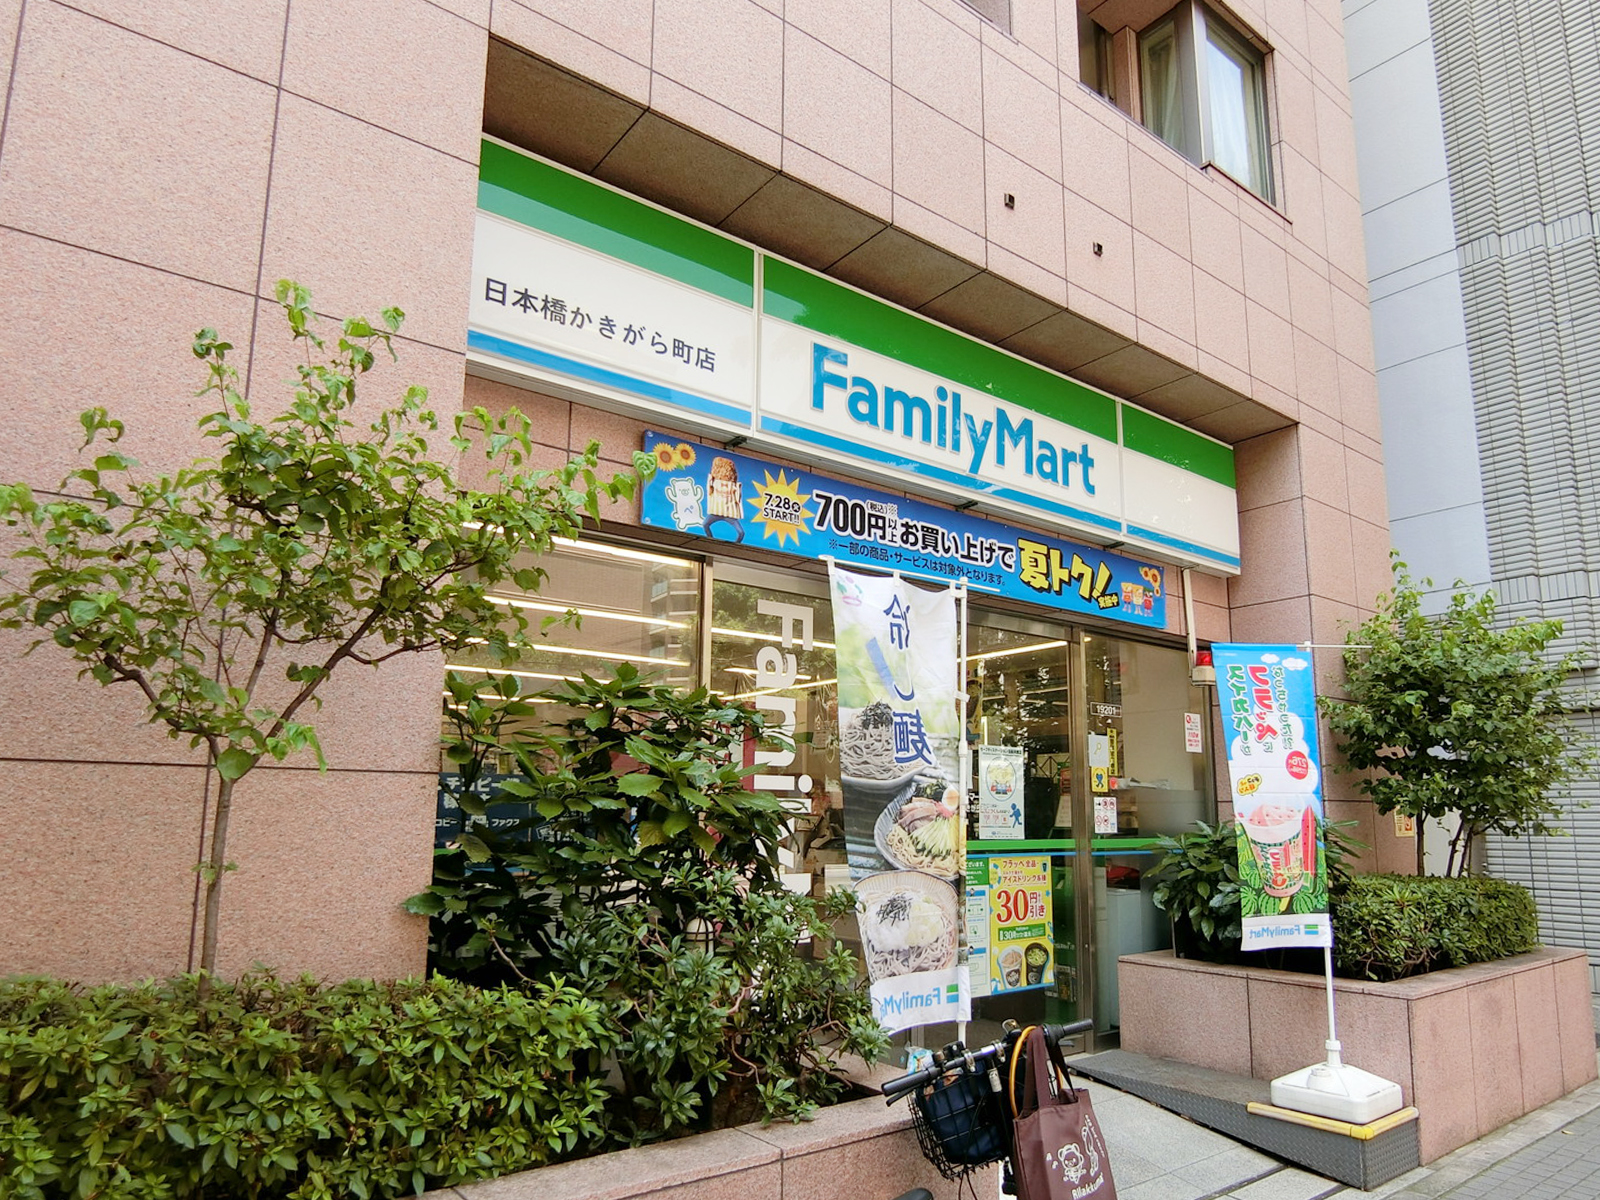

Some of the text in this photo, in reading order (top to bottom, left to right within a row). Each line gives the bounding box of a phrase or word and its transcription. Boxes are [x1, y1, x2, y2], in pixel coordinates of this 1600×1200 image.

[485, 277, 716, 372] 日本橋かきがら町店
[810, 342, 1095, 496] FamilyMart
